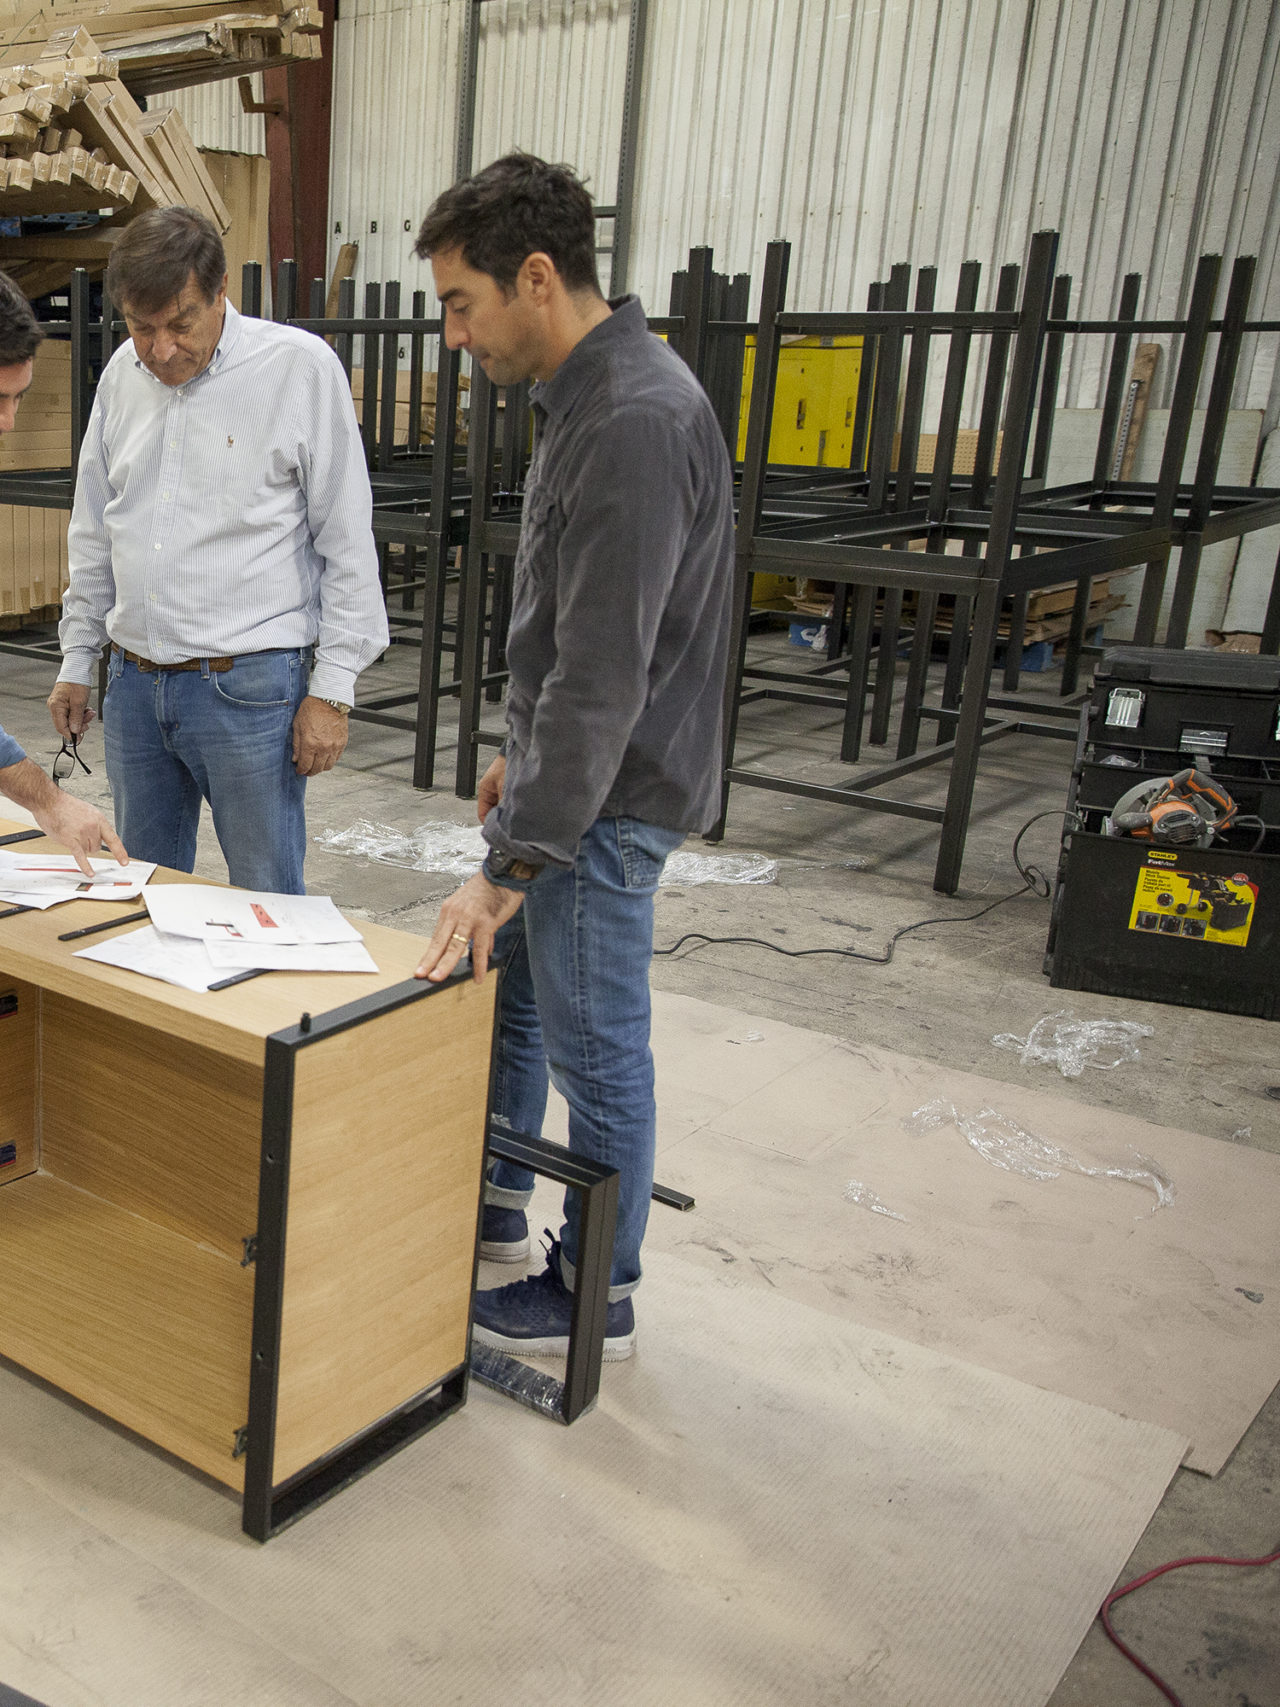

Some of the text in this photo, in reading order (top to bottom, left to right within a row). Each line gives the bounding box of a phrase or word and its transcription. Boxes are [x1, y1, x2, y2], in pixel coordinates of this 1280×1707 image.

[334, 221, 341, 234] A
[370, 221, 377, 233] B
[398, 347, 405, 360] 6
